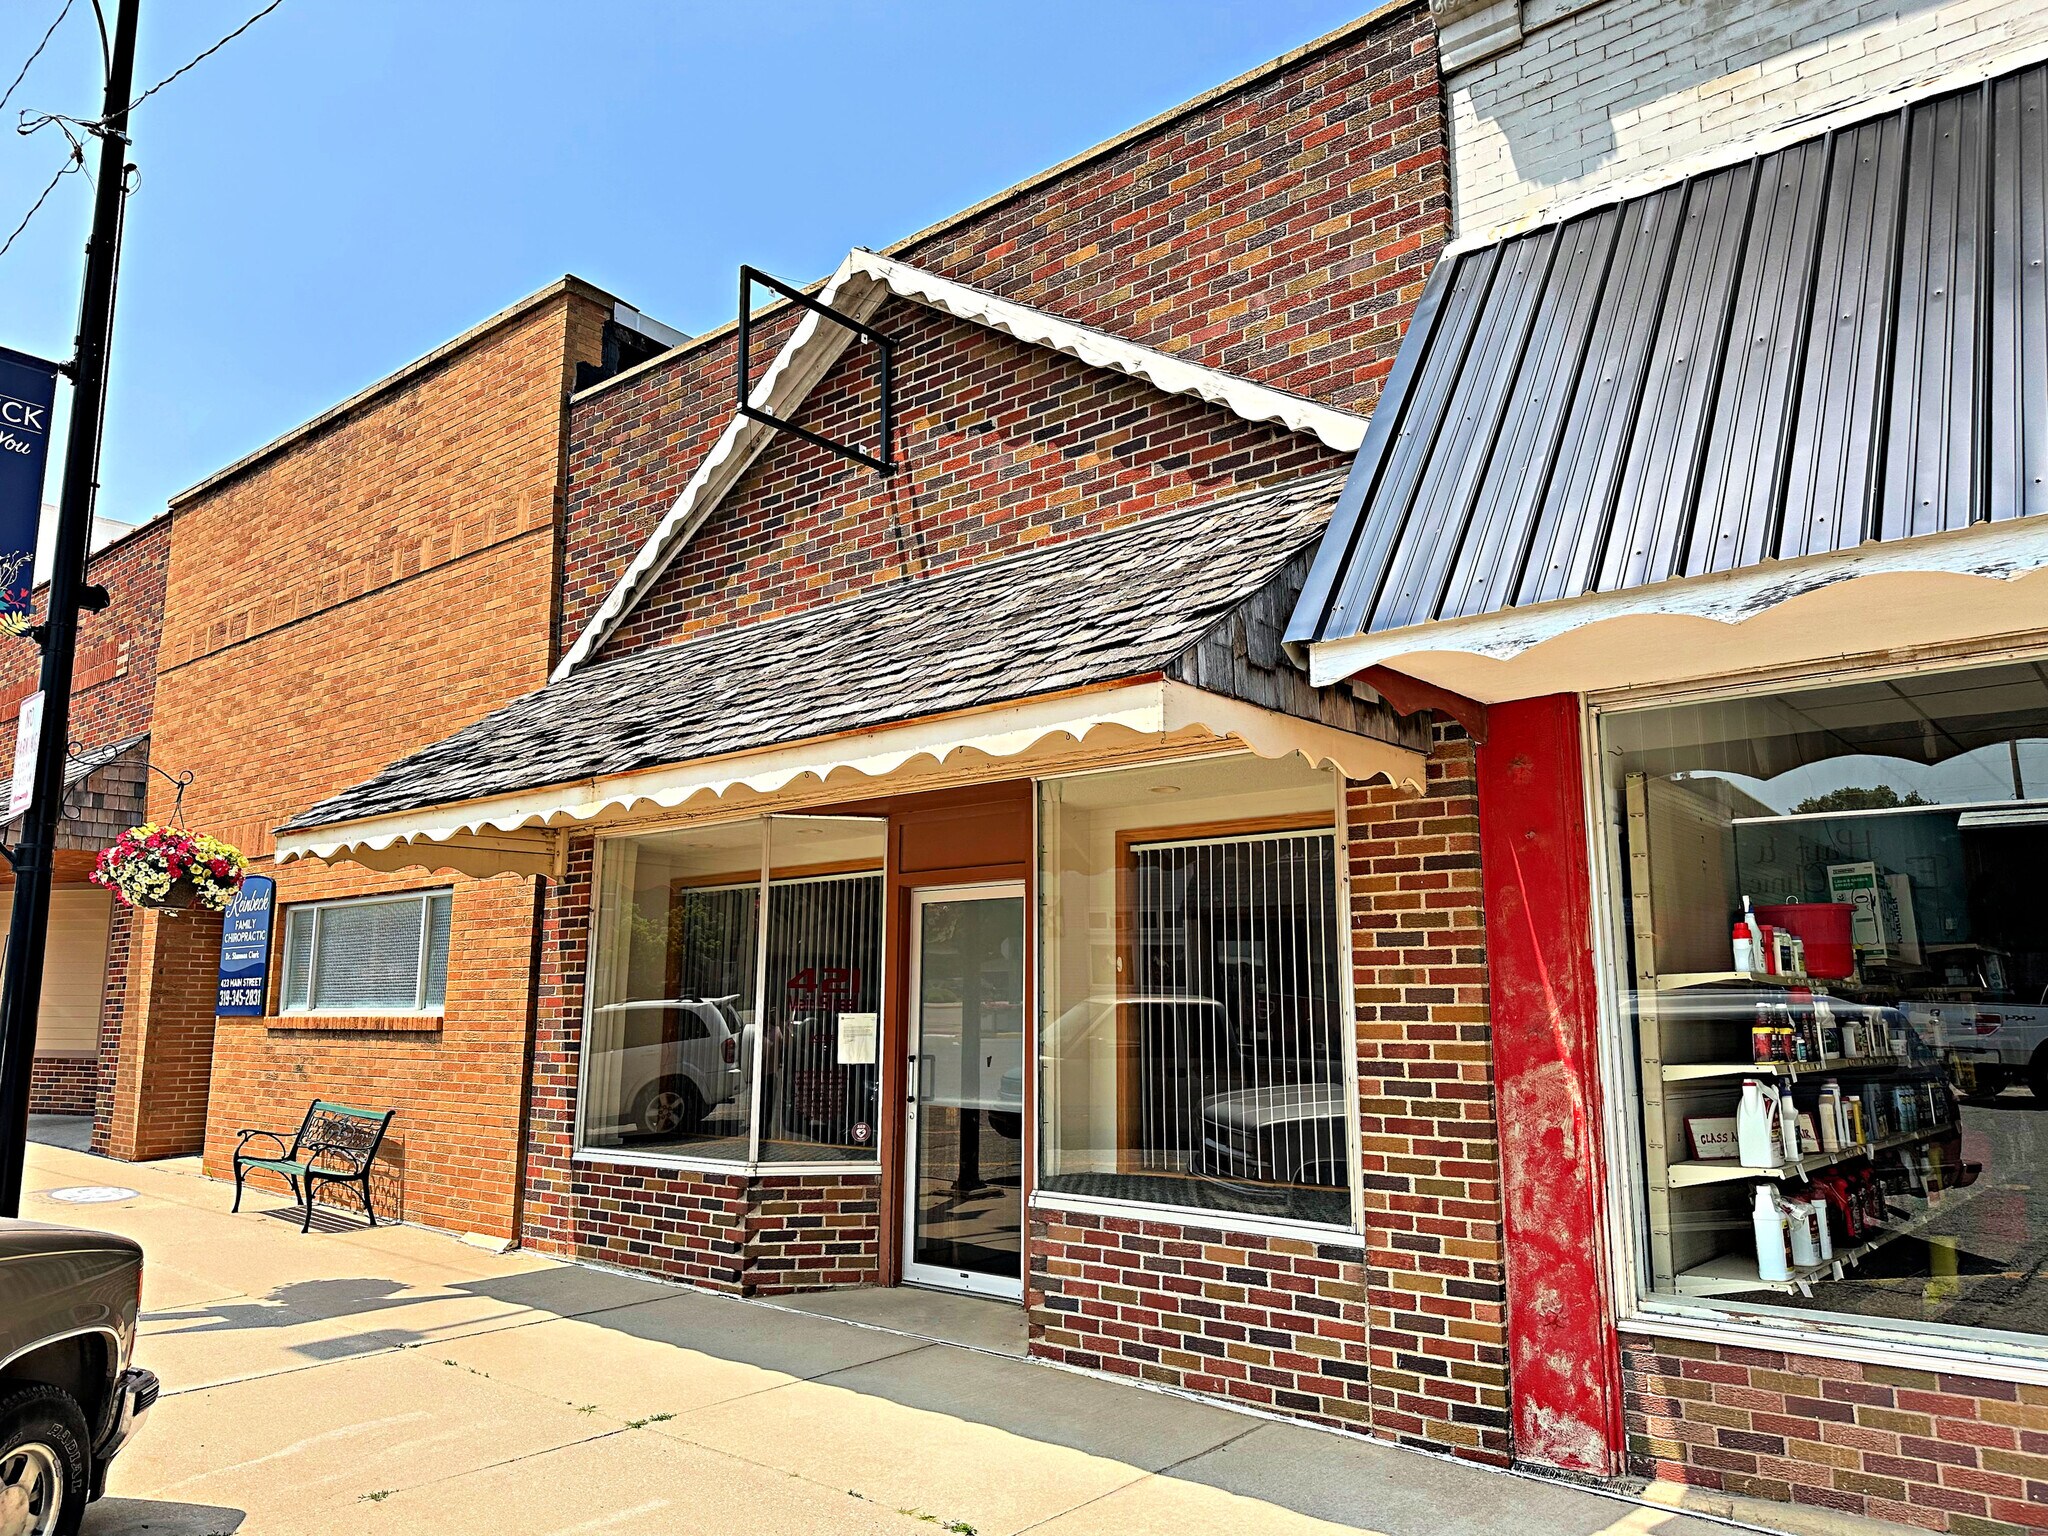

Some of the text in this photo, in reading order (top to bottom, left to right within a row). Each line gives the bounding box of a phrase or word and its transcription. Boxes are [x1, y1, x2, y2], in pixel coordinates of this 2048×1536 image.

[0, 399, 44, 430] CK
[226, 889, 269, 918] Reinbeck
[235, 918, 256, 930] FAMILY
[224, 930, 266, 943] CHIROPRACTIC
[220, 977, 262, 988] 423 MAIN STREET
[787, 968, 860, 993] 421
[219, 989, 260, 1006] 319-345-2831
[788, 993, 815, 1012] Main
[46, 1423, 83, 1494] RADIAL
